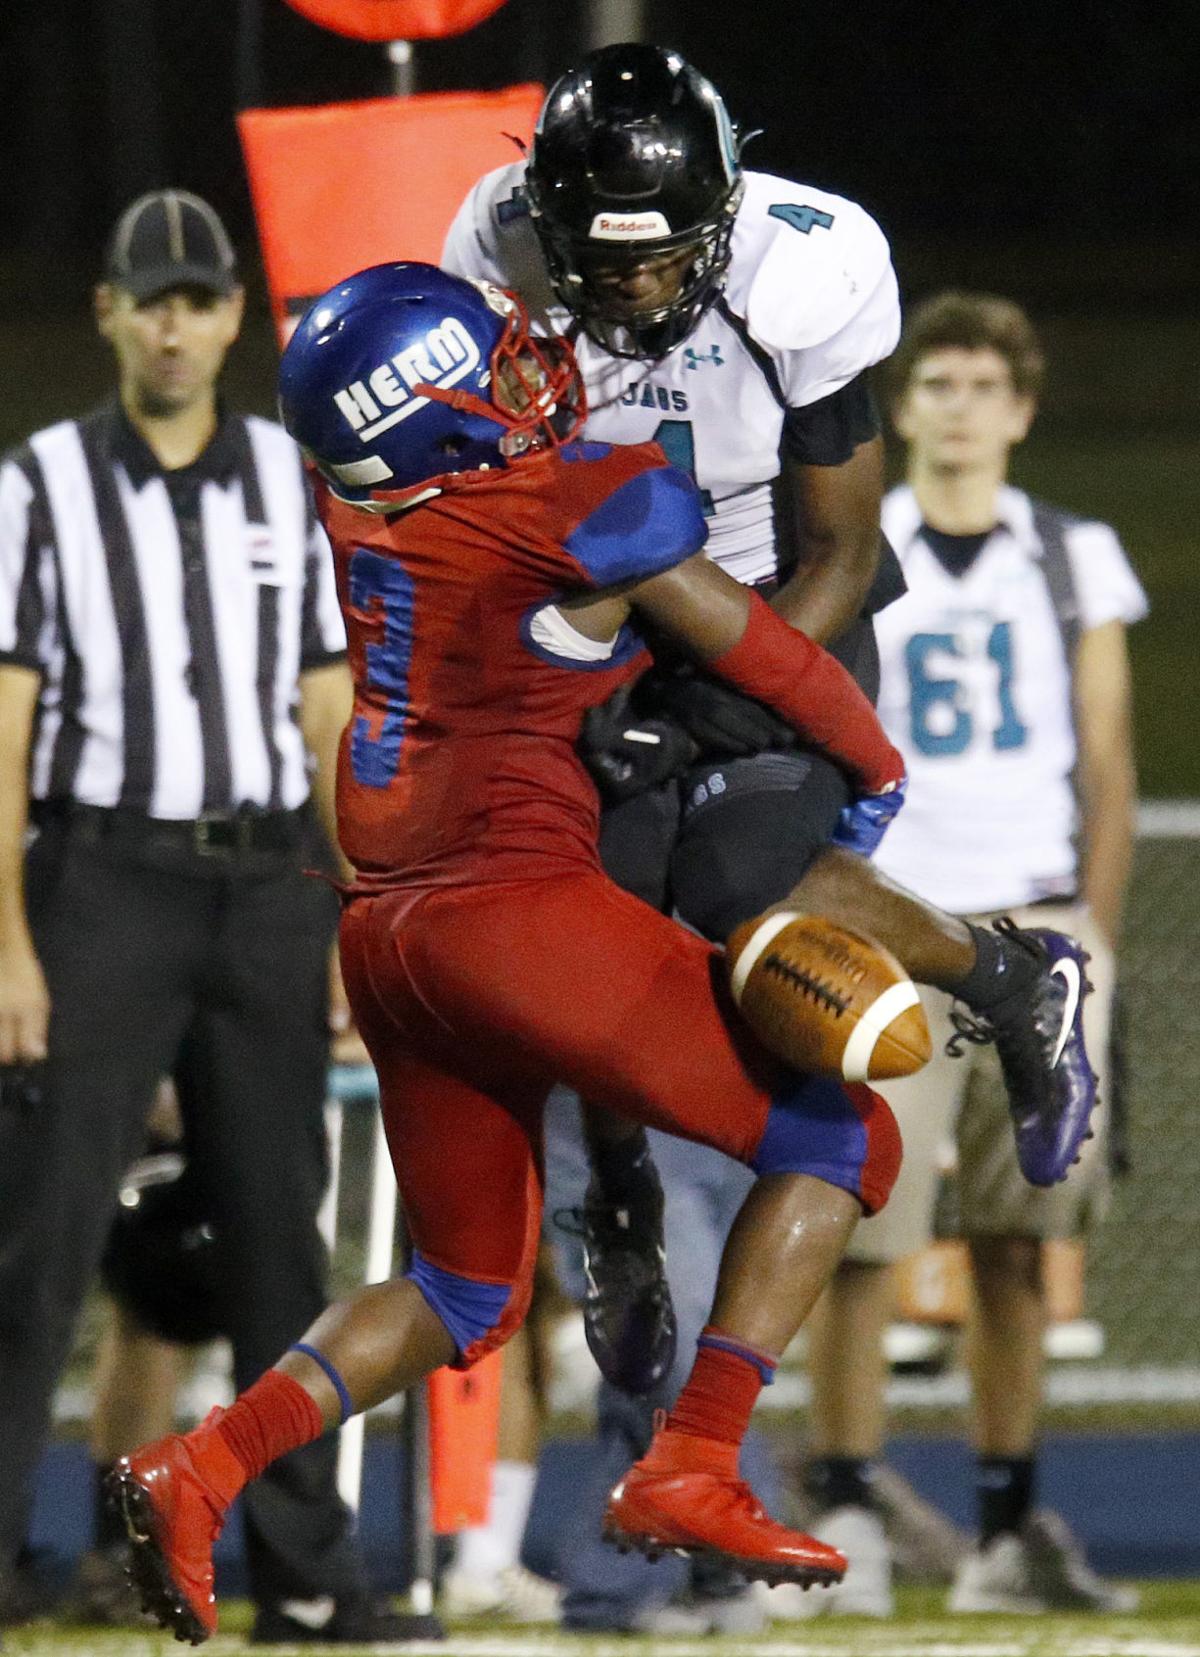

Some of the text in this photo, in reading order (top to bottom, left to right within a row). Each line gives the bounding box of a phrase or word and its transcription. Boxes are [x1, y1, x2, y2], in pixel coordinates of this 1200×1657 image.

[767, 203, 835, 235] 4
[333, 317, 480, 443] HERM
[905, 622, 1028, 757] 61
